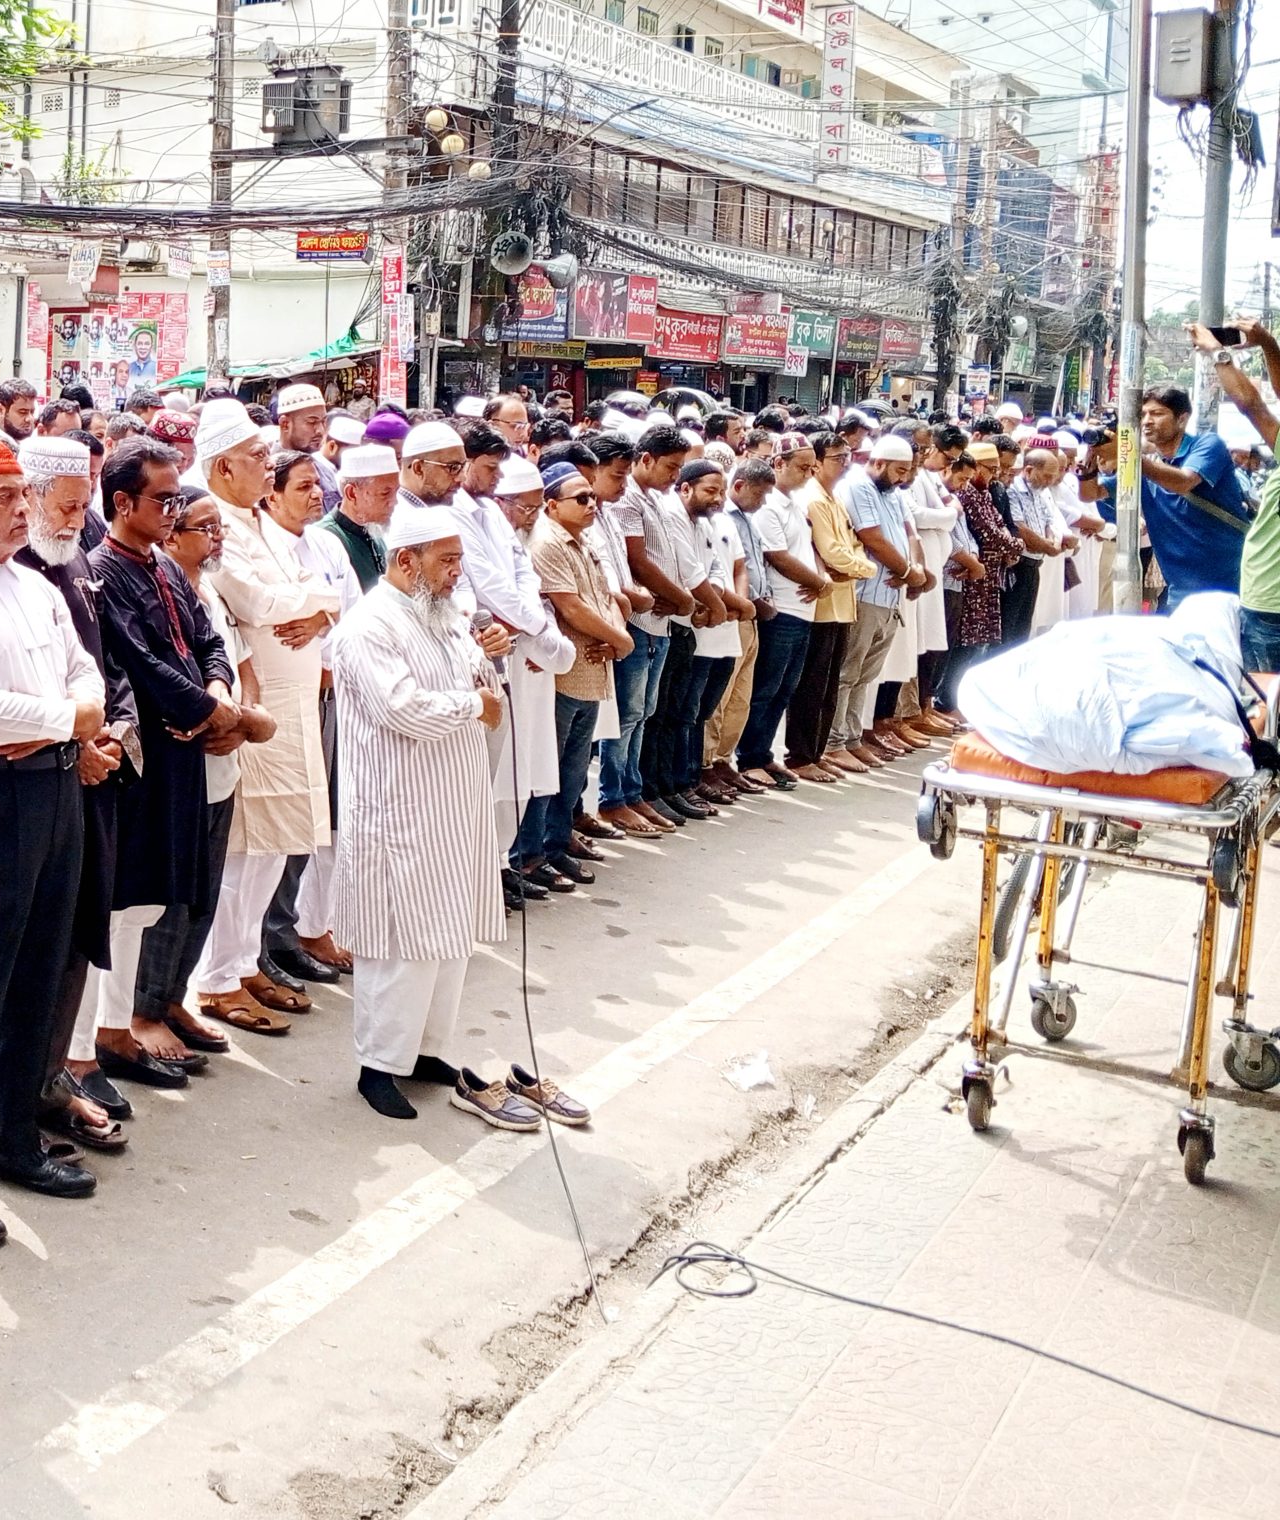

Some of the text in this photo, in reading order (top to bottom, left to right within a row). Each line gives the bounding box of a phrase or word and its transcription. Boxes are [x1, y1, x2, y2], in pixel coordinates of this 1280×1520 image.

[654, 316, 689, 342] অংকুর
[796, 322, 812, 347] বুক
[813, 317, 834, 345] ভিলা
[847, 341, 861, 349] Brand
[862, 341, 877, 351] Optics
